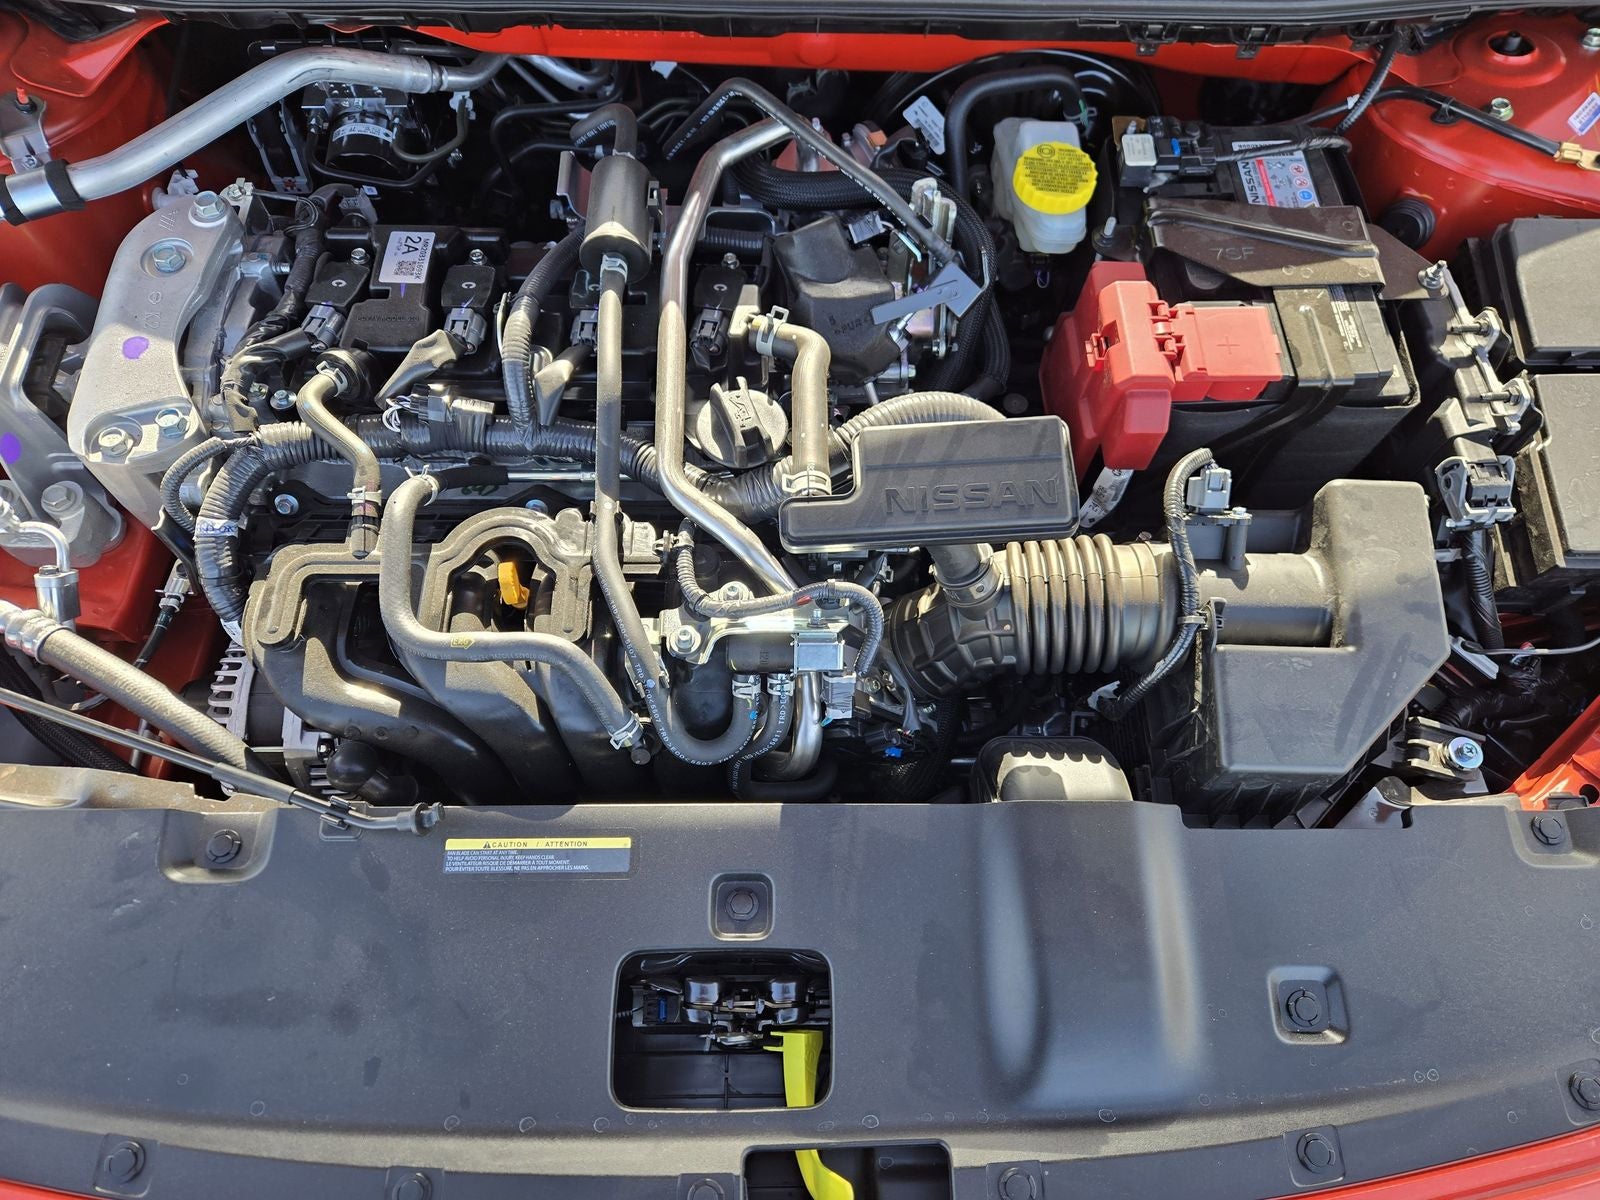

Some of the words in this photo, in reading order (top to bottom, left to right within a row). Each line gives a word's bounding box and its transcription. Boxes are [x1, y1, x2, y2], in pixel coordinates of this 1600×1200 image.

[1240, 160, 1260, 204] NISSAN
[401, 235, 422, 255] 2A
[884, 477, 1060, 514] NISSAN
[545, 840, 588, 848] ATTENTION
